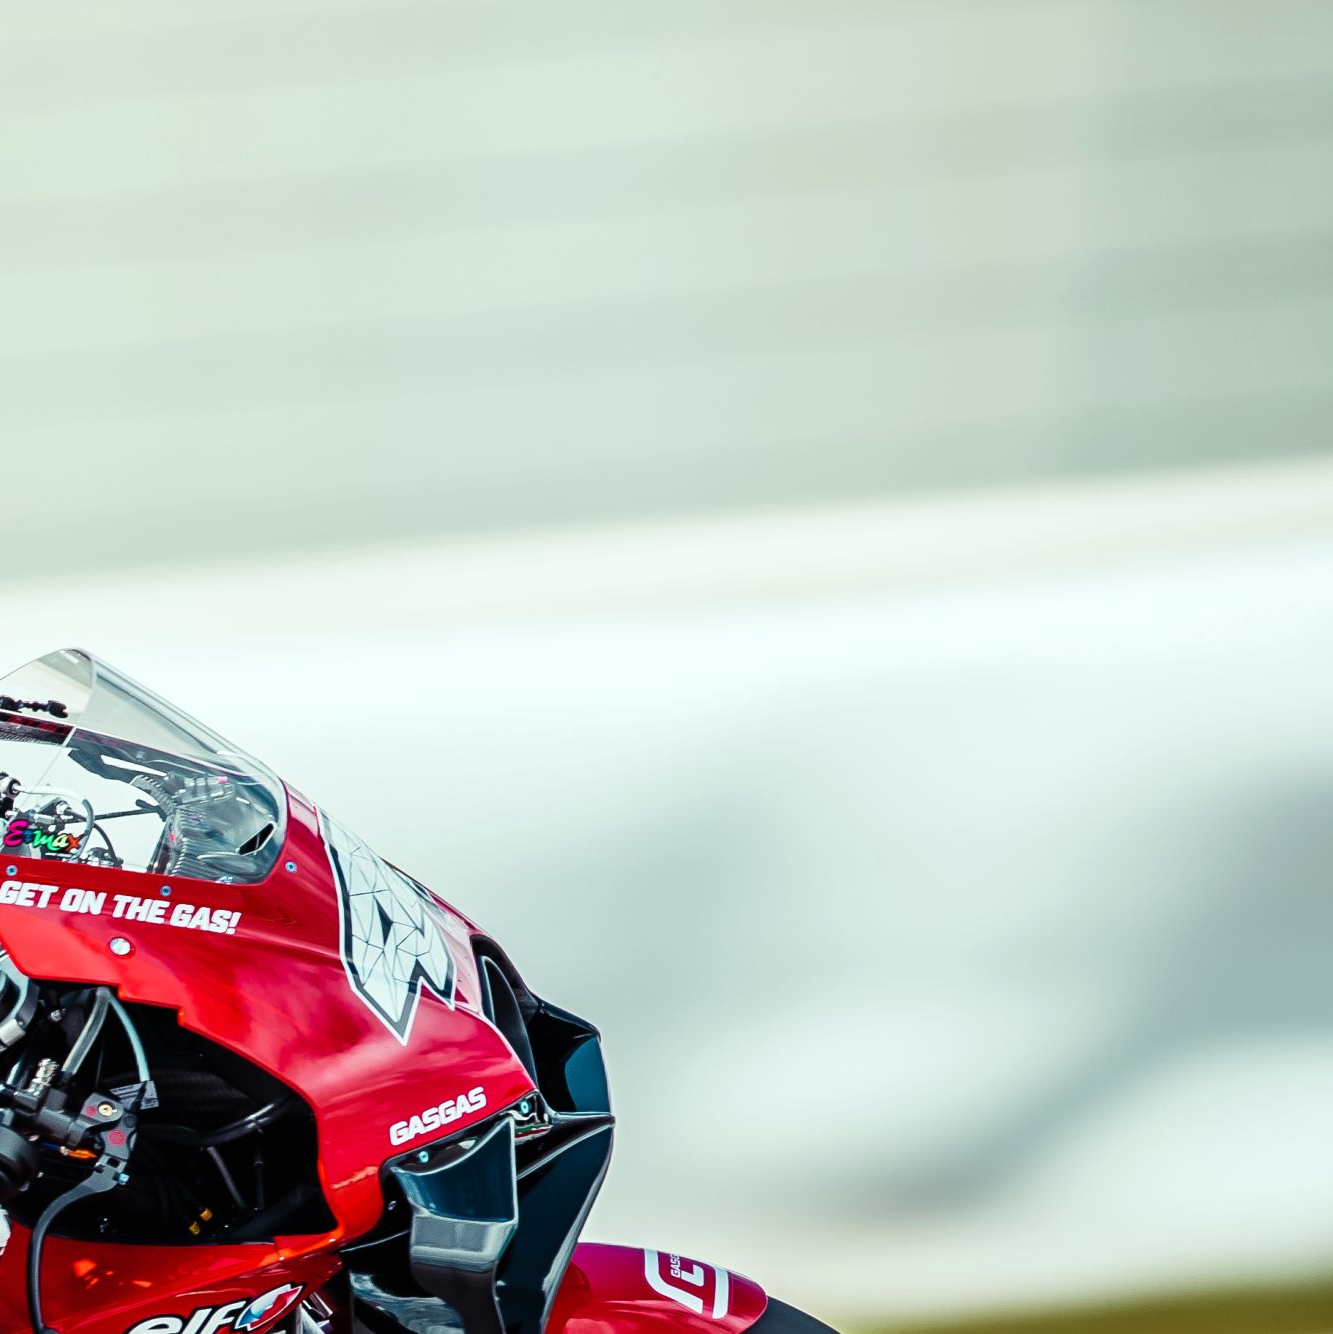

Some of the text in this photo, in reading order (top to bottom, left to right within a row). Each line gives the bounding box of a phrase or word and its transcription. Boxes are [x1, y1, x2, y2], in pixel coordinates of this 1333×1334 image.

[59, 888, 107, 915] ON
[111, 894, 170, 924] THE
[169, 904, 242, 935] GAS!
[388, 1085, 488, 1147] GASGAS
